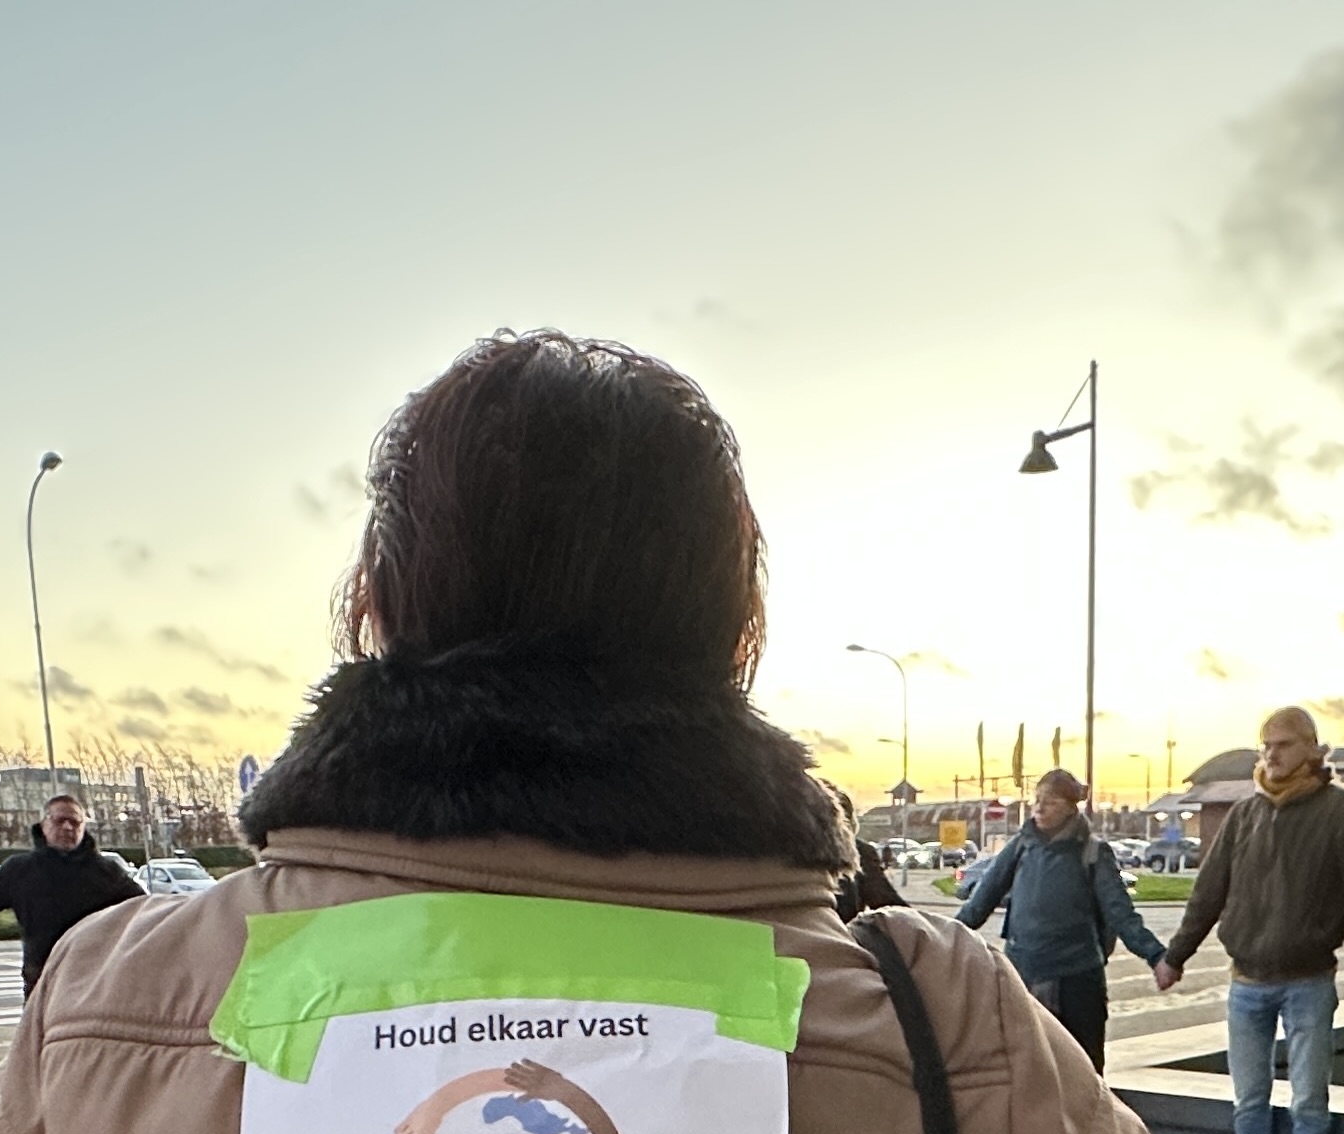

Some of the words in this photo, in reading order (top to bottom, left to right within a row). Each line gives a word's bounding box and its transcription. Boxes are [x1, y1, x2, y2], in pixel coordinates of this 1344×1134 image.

[375, 1017, 457, 1049] Houd
[468, 1015, 569, 1042] elkaar
[578, 1013, 649, 1037] vast
